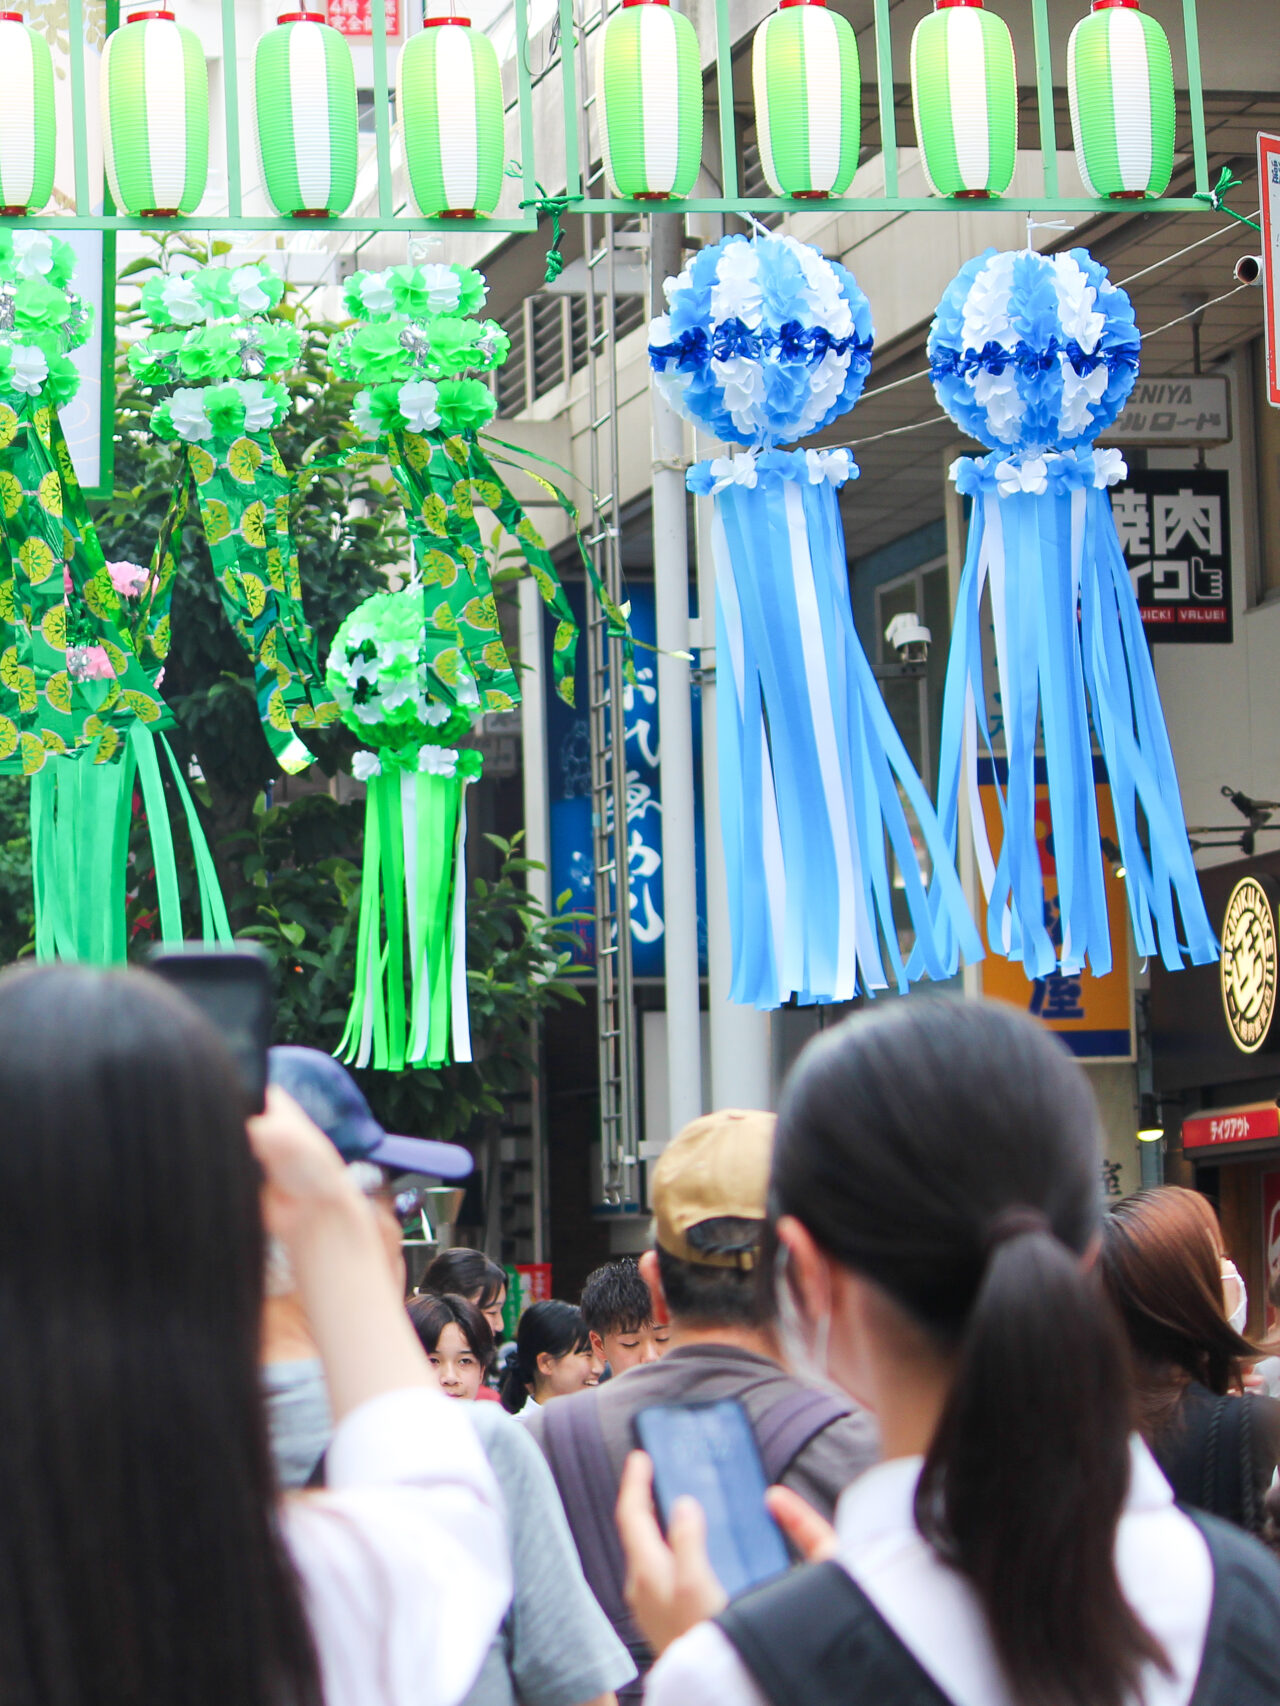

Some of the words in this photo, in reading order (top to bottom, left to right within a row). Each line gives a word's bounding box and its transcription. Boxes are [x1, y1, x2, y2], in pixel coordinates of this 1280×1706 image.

[1126, 384, 1192, 404] ENIYA
[1180, 609, 1225, 621] VALUE!
[1210, 1115, 1250, 1142] テイクアウト
